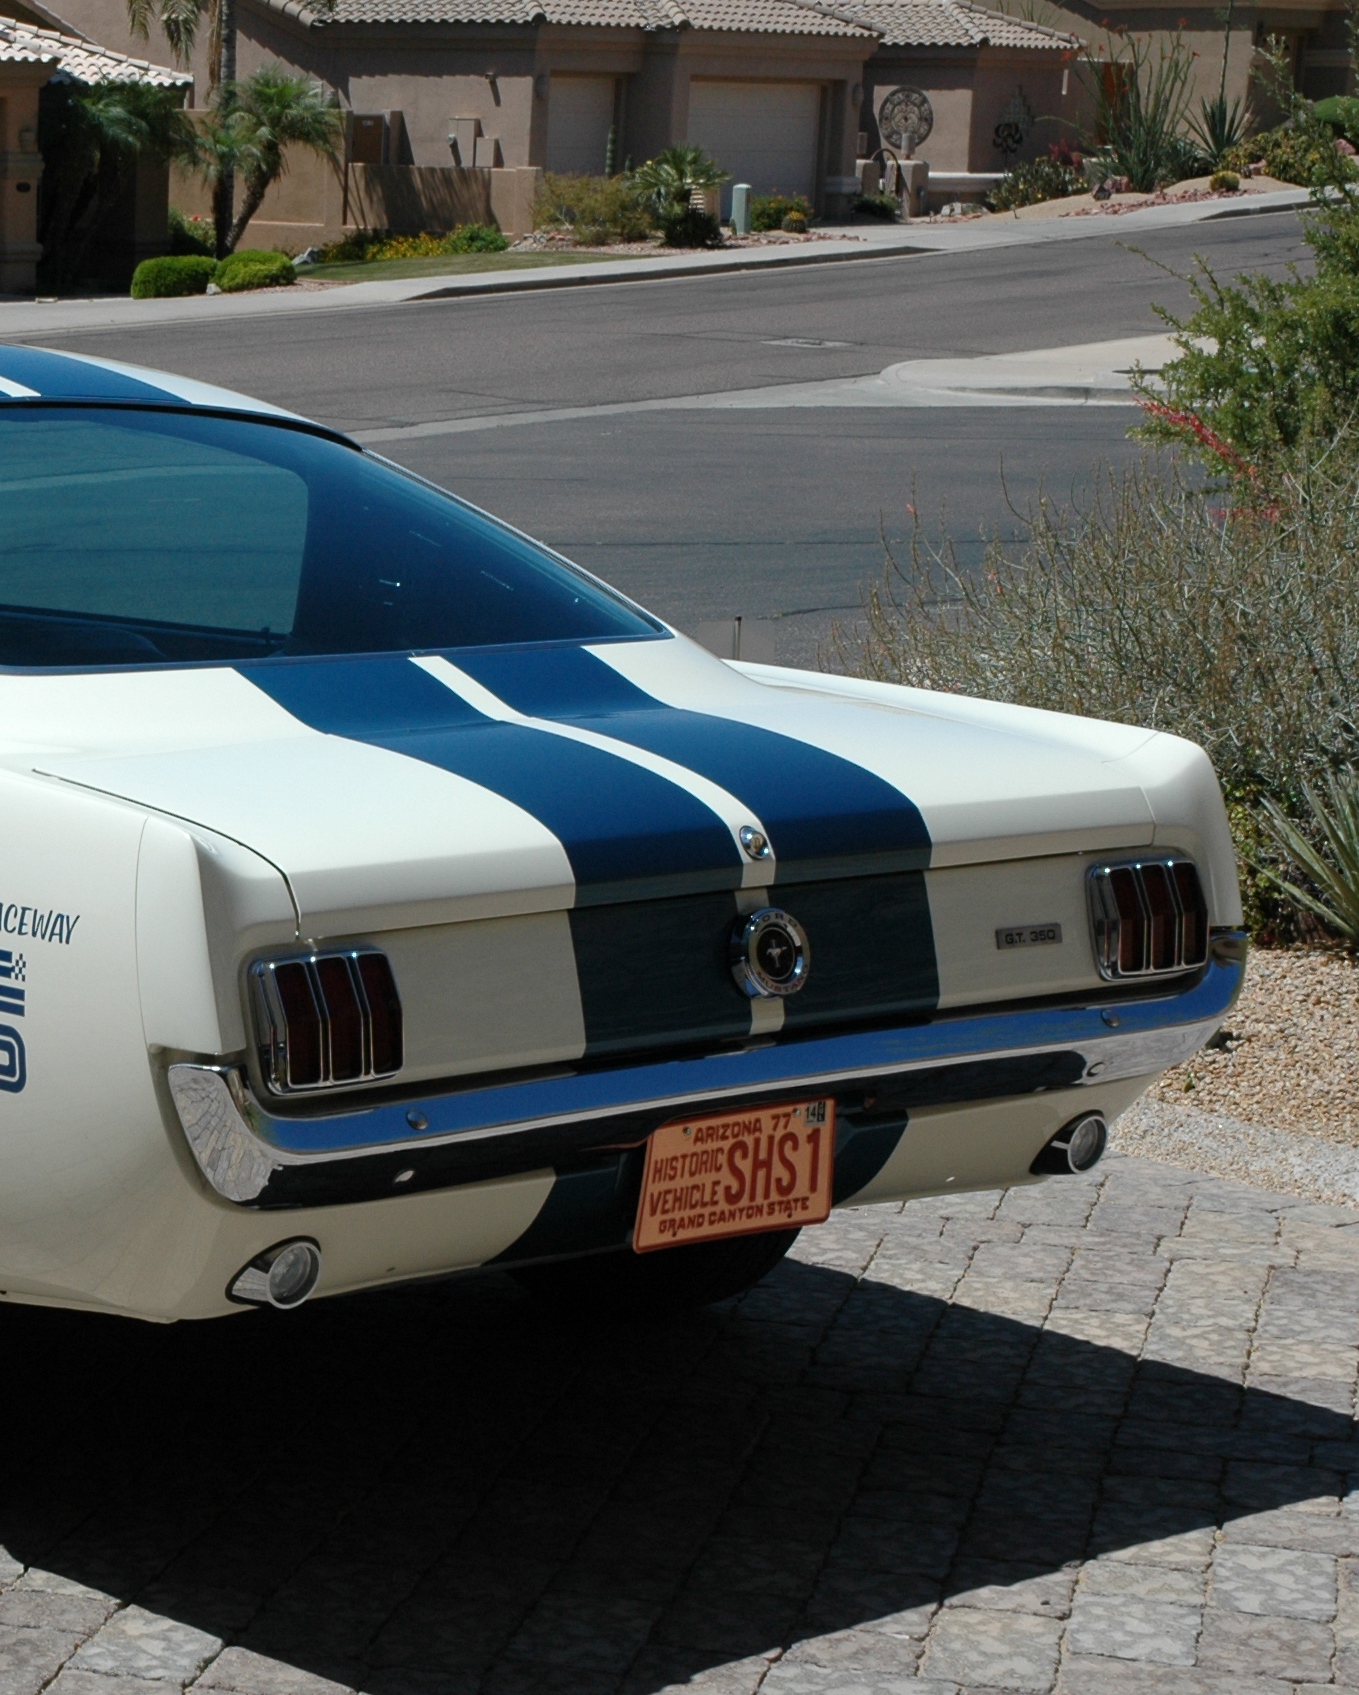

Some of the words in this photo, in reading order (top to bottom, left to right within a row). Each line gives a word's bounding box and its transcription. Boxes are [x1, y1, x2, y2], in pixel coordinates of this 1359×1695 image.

[1029, 929, 1056, 942] 350
[693, 1117, 763, 1147] ARIZONA
[770, 1112, 792, 1132] 77
[652, 1147, 725, 1184] HISTORIC
[649, 1180, 722, 1217] VEHICLE
[658, 1212, 705, 1234] GRAND
[707, 1204, 764, 1226] CANYON
[766, 1196, 810, 1217] STATE
